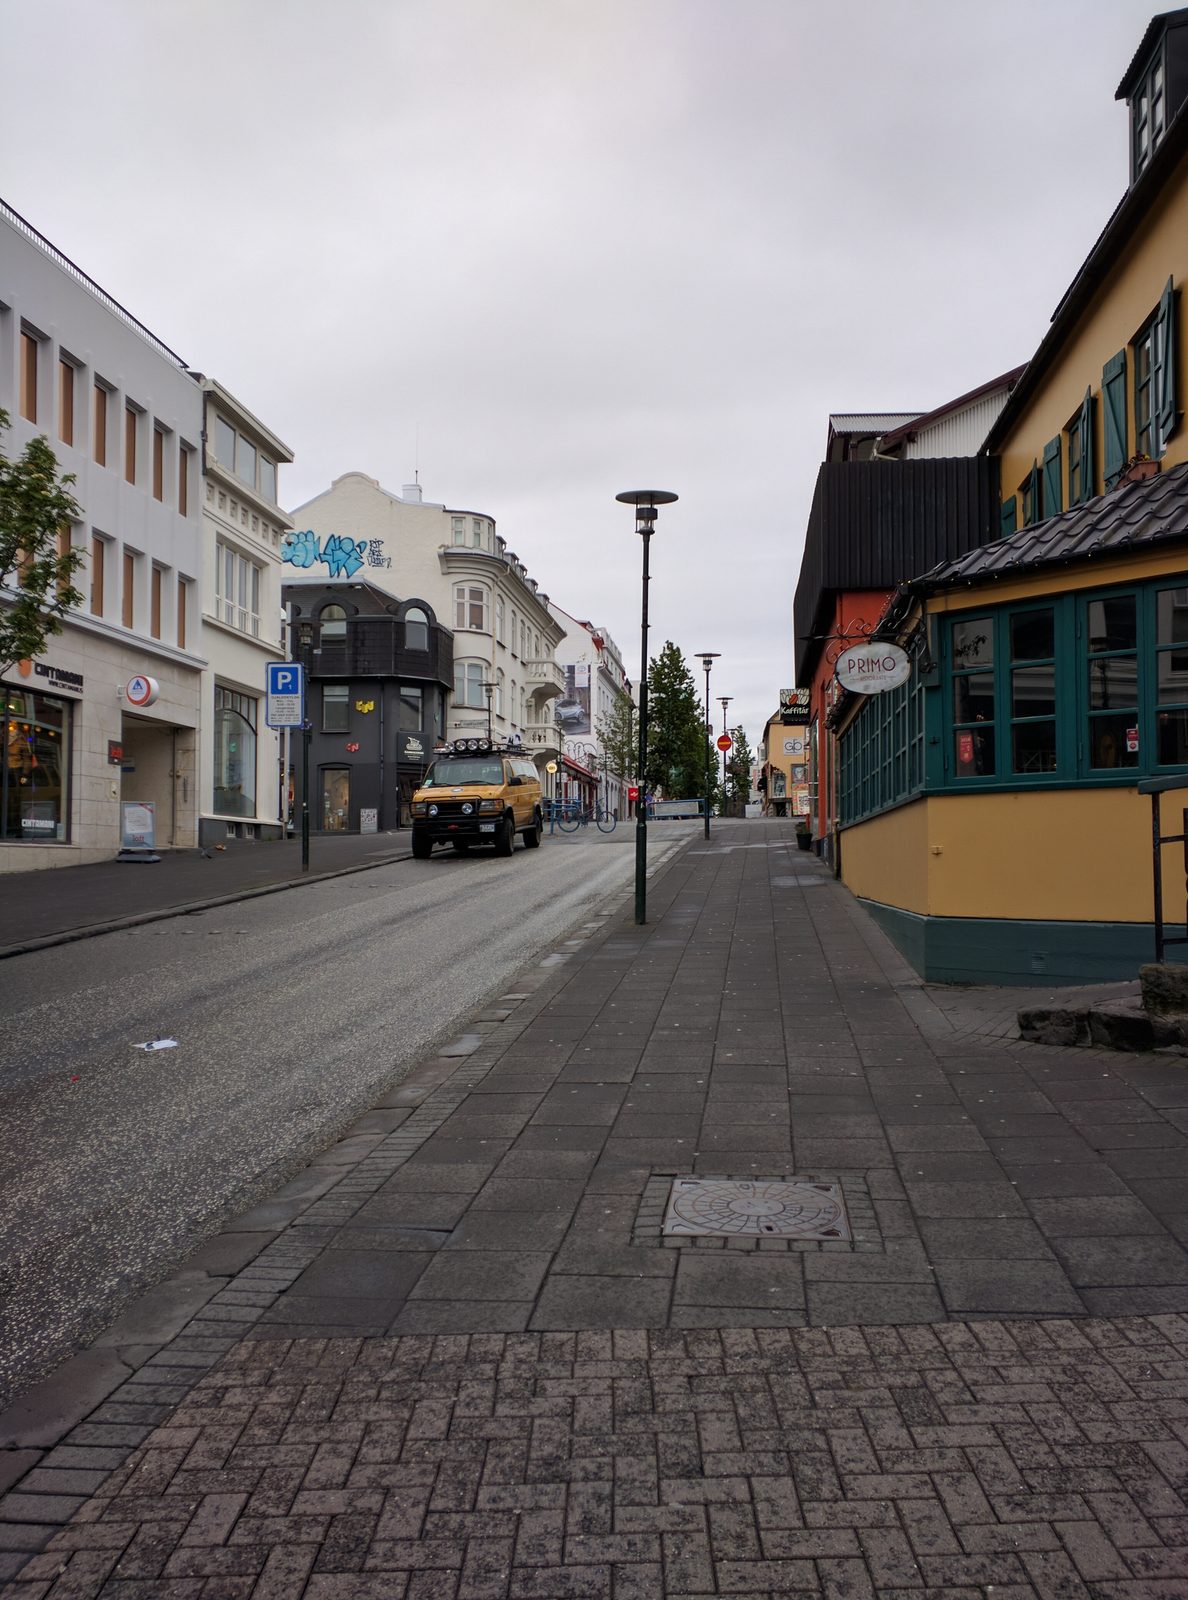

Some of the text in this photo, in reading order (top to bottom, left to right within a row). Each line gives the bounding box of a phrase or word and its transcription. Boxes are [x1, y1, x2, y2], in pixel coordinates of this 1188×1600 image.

[847, 656, 896, 674] PRIMO
[277, 671, 292, 690] P
[781, 706, 809, 714] Kaffitár
